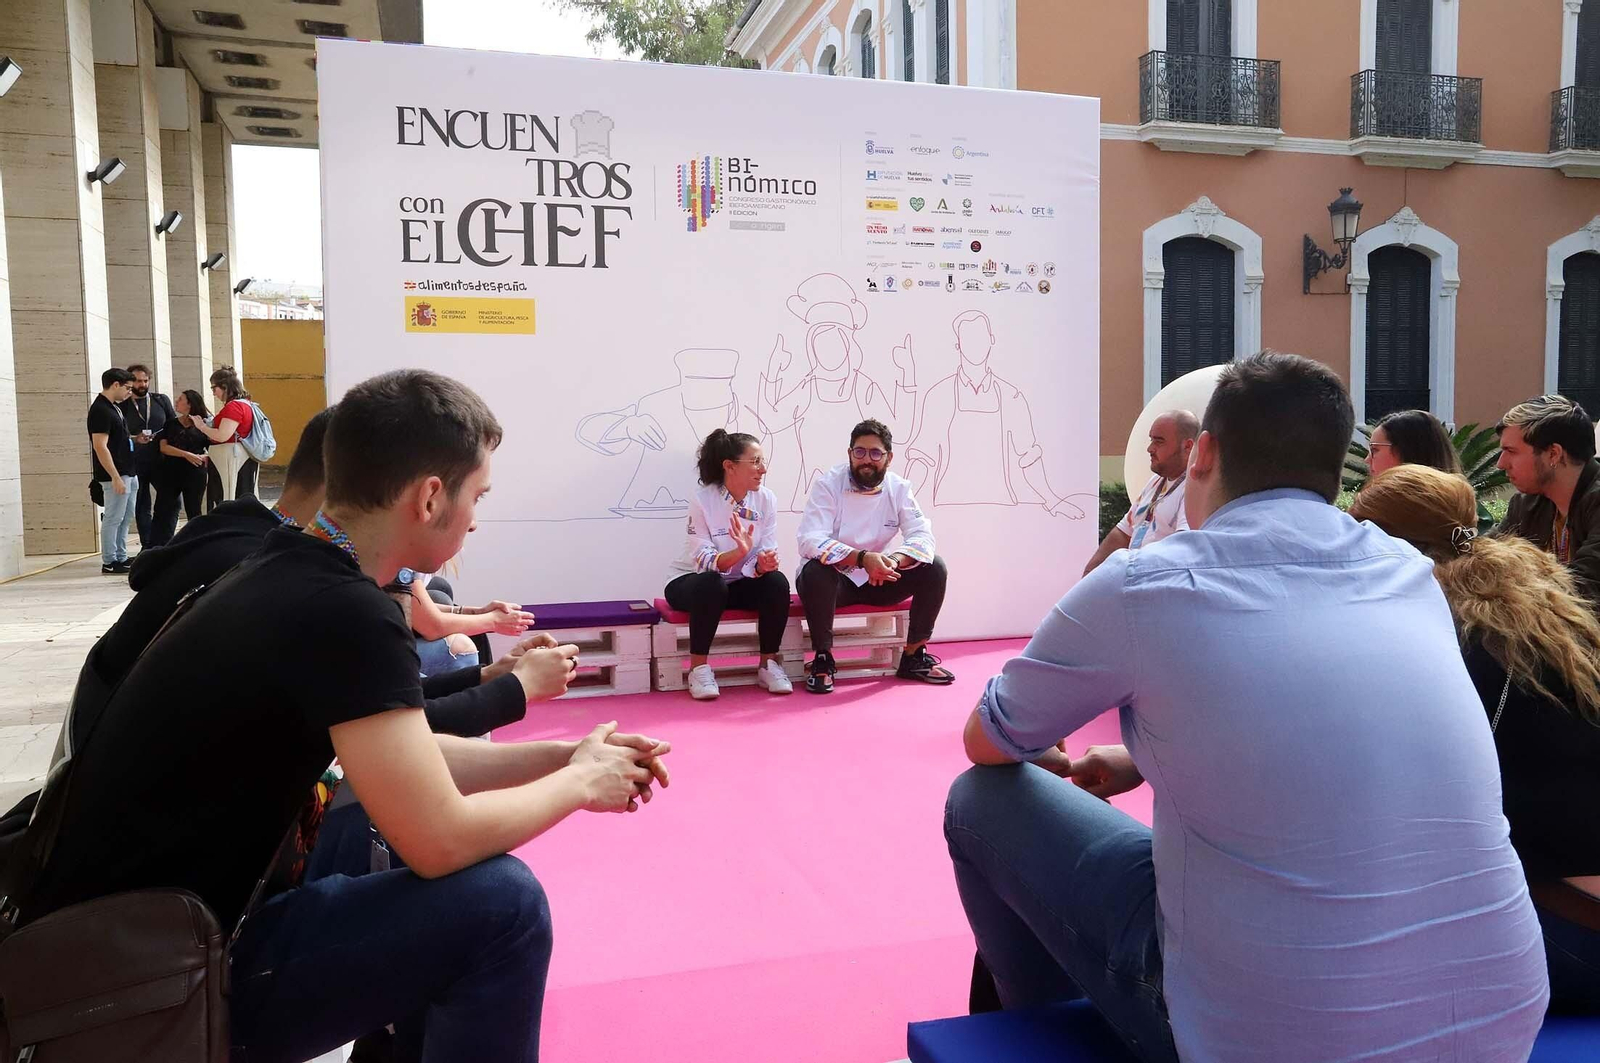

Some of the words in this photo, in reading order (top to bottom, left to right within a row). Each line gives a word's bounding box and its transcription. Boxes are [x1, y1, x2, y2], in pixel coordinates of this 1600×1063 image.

[396, 106, 560, 154] ENCUEN
[525, 158, 632, 200] TROS
[400, 196, 444, 214] con
[400, 219, 462, 264] EL
[457, 198, 633, 268] CHEF
